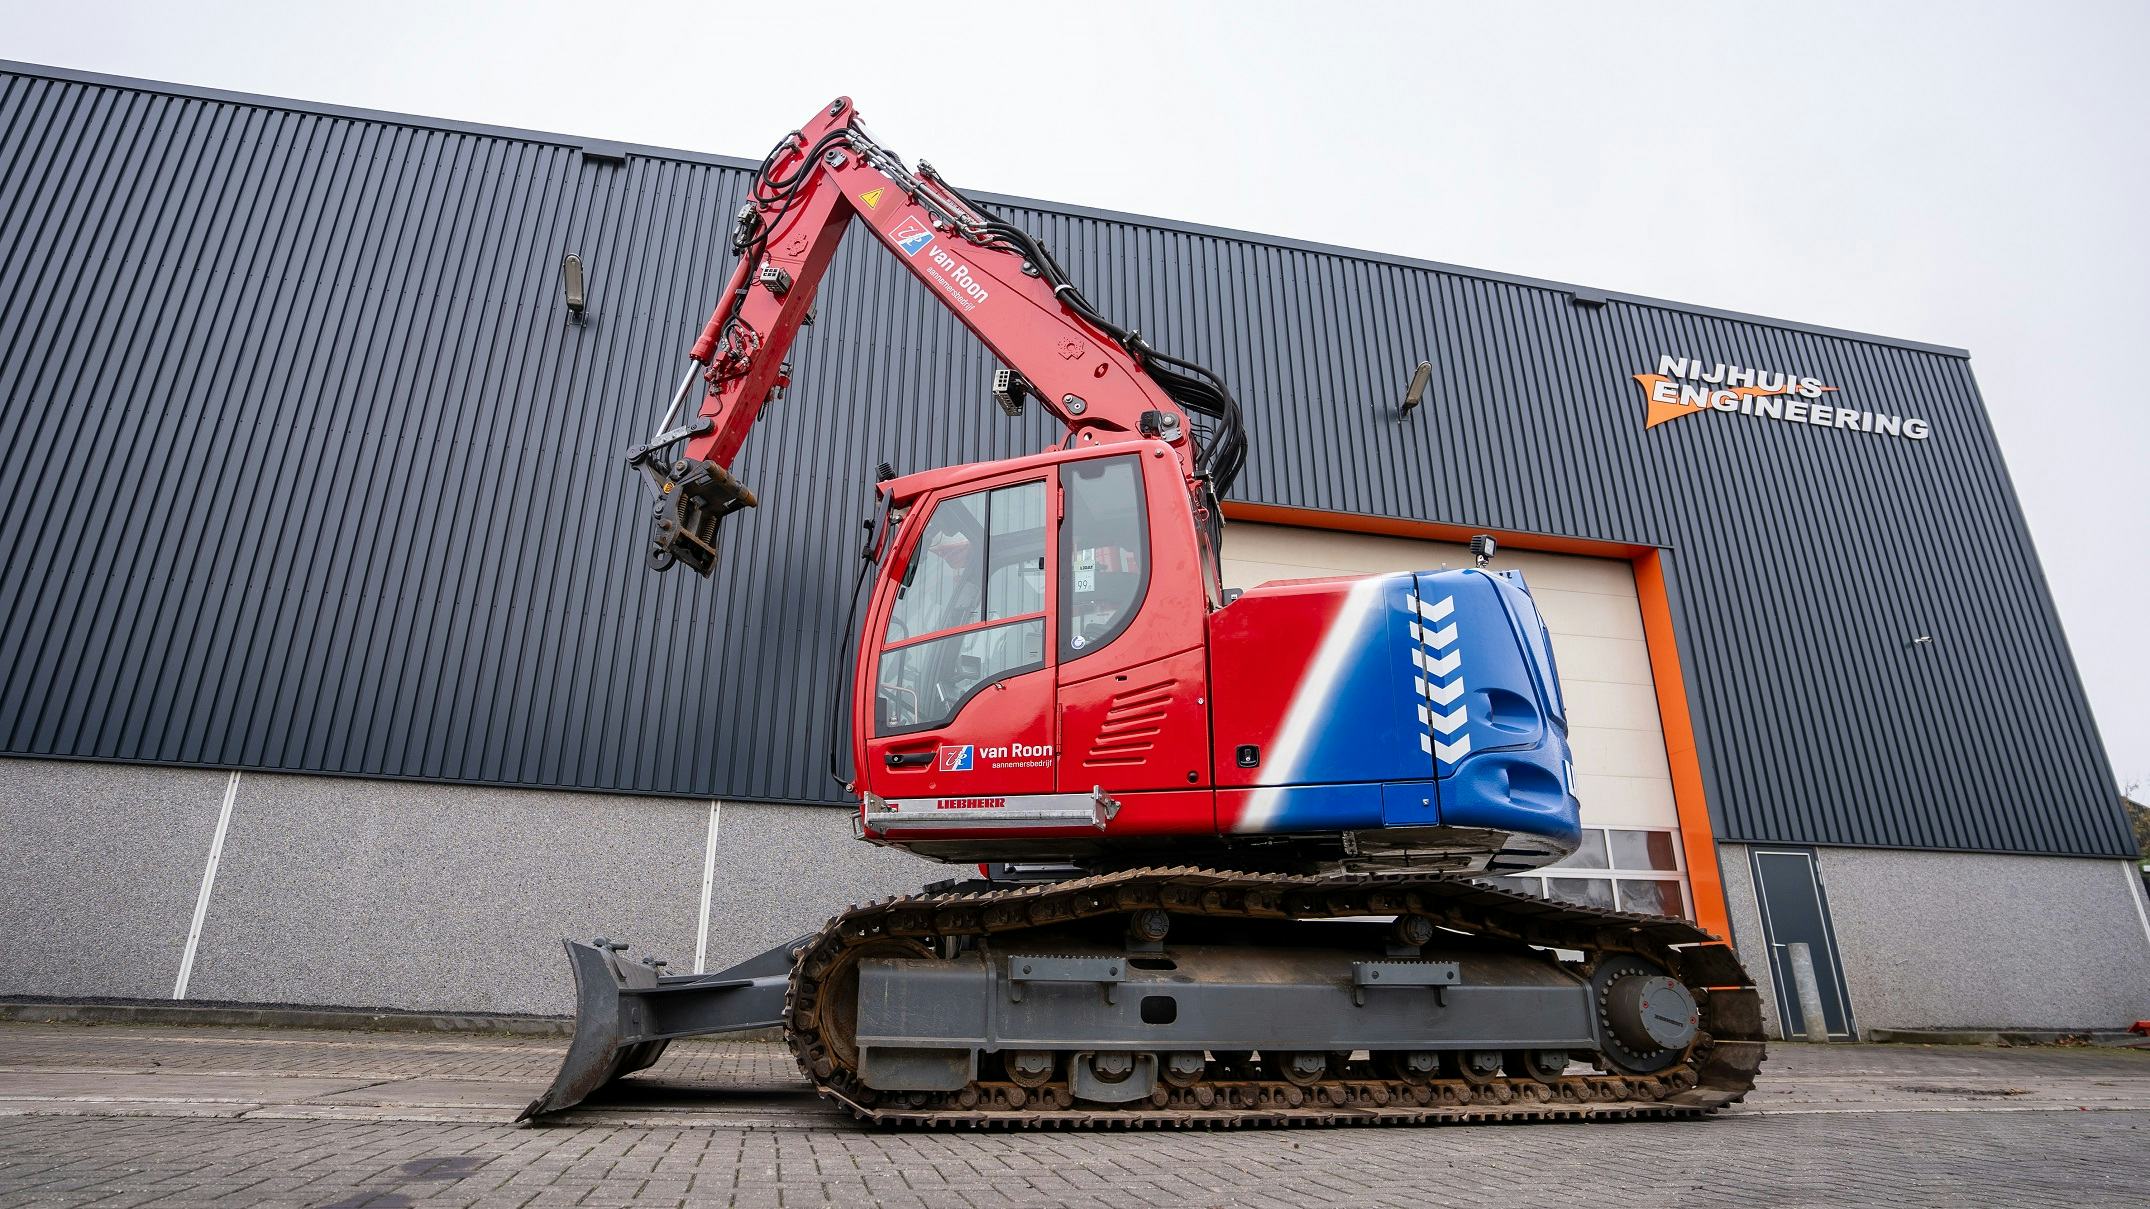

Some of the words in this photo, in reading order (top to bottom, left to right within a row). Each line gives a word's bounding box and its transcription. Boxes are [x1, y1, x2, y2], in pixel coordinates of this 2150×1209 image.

[927, 267, 975, 311] aannemersbedrijf
[929, 245, 955, 271] van
[951, 265, 989, 303] Roon
[1657, 354, 1823, 399] NIJHUIS
[1652, 380, 1929, 440] ENGINEERING
[979, 746, 1008, 759] van
[1011, 742, 1053, 758] Roon
[991, 759, 1053, 769] aannemersbedrijf
[937, 798, 1006, 809] LIEBHERR
